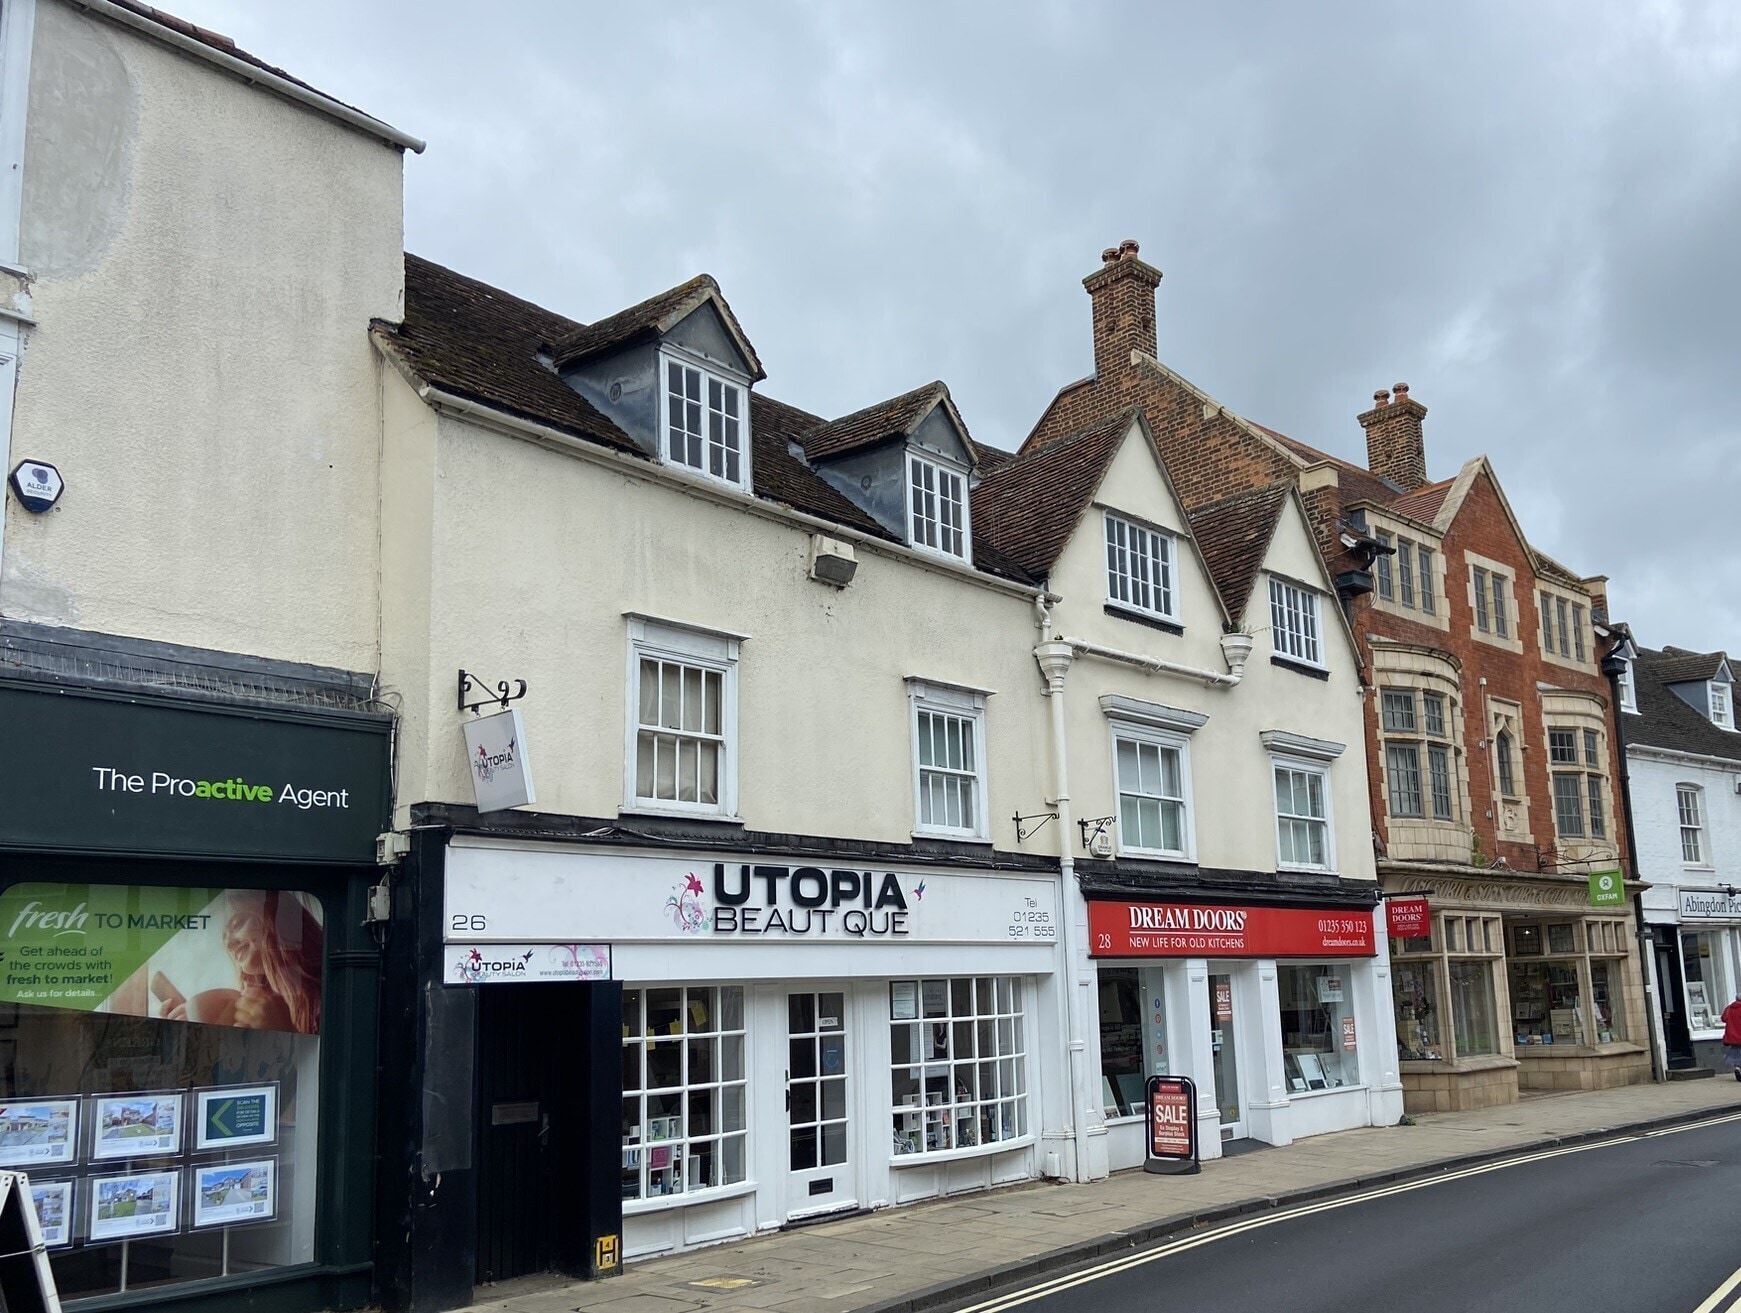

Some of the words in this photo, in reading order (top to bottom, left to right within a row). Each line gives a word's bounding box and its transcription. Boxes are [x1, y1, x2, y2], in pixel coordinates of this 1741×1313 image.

[27, 482, 52, 491] ALDER
[482, 751, 513, 768] UTOPIA
[92, 766, 145, 792] The
[151, 771, 273, 802] Proactive
[278, 783, 349, 809] Agent
[713, 863, 908, 910] UTOPIA
[1597, 893, 1618, 901] OXFAM
[1024, 898, 1037, 908] Tel
[1685, 895, 1727, 917] Abingdon
[1391, 905, 1423, 914] DREAM
[8, 901, 89, 938] fresh
[94, 914, 123, 929] TO
[128, 914, 211, 929] MARKET
[452, 914, 486, 930] 26
[1013, 911, 1049, 922] 01235
[1129, 906, 1190, 929] DREAM
[1193, 909, 1244, 931] DOORS
[1392, 914, 1421, 922] DOORS
[1008, 925, 1029, 936] 521
[1033, 926, 1055, 936] 555
[1318, 919, 1340, 933] 01235
[1340, 920, 1354, 933] 350
[1355, 920, 1367, 933] 123
[1098, 933, 1111, 948] 28
[1130, 937, 1150, 948] NEW
[1152, 937, 1169, 948] LIFE
[1171, 937, 1187, 948] FOR
[1189, 938, 1206, 948] OLD
[1208, 938, 1244, 948] KITCHENS
[1322, 936, 1366, 946] dreamdoors.co.uk
[20, 946, 43, 957] Get
[47, 946, 87, 957] ahead
[90, 946, 104, 956] of
[9, 960, 31, 971] the
[34, 960, 82, 971] crowds
[86, 960, 112, 970] with
[471, 958, 526, 971] UTOPIA
[7, 974, 41, 985] fresh
[45, 975, 59, 985] to
[62, 974, 113, 984] market!
[16, 990, 34, 998] Ask
[50, 990, 62, 998] for
[1216, 990, 1230, 1002] SALE
[1155, 1104, 1187, 1124] SALE
[605, 1241, 610, 1249] 4
